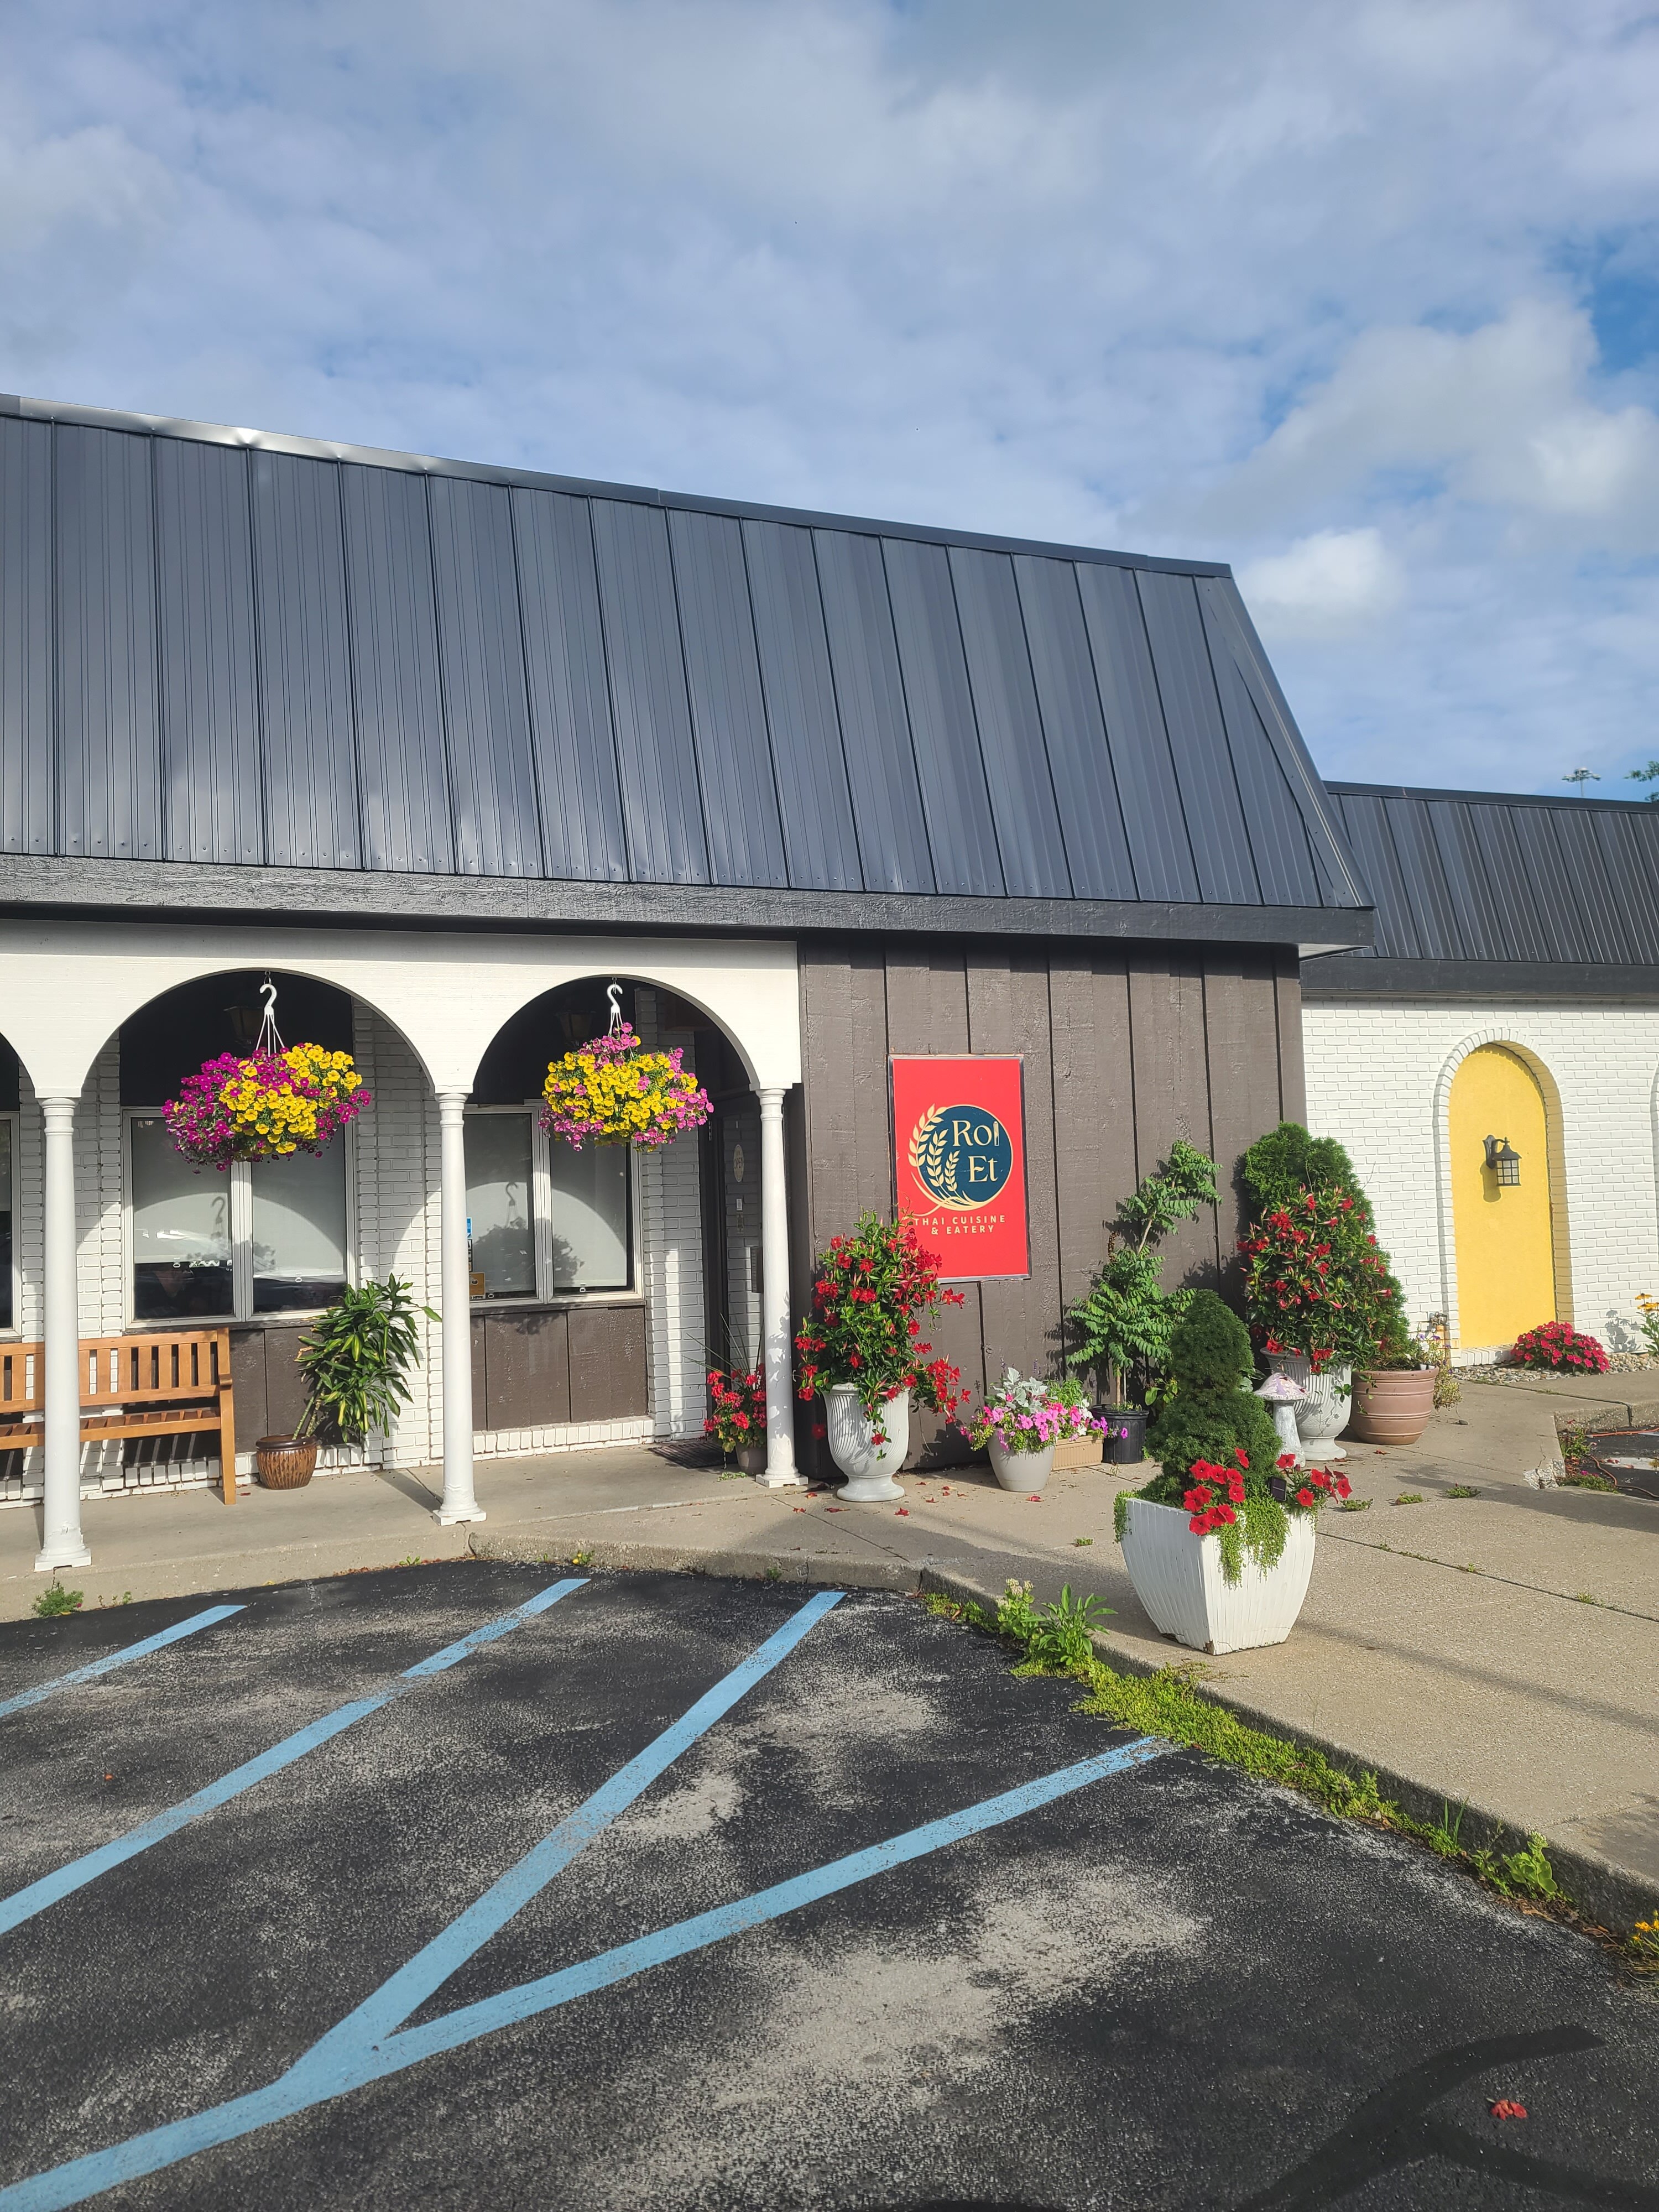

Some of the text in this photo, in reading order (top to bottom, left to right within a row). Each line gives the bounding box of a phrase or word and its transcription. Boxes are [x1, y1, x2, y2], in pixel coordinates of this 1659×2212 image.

[968, 1156, 998, 1182] Et
[914, 1215, 1005, 1226] THAI CUISINE
[931, 1225, 994, 1235] & EATERY
